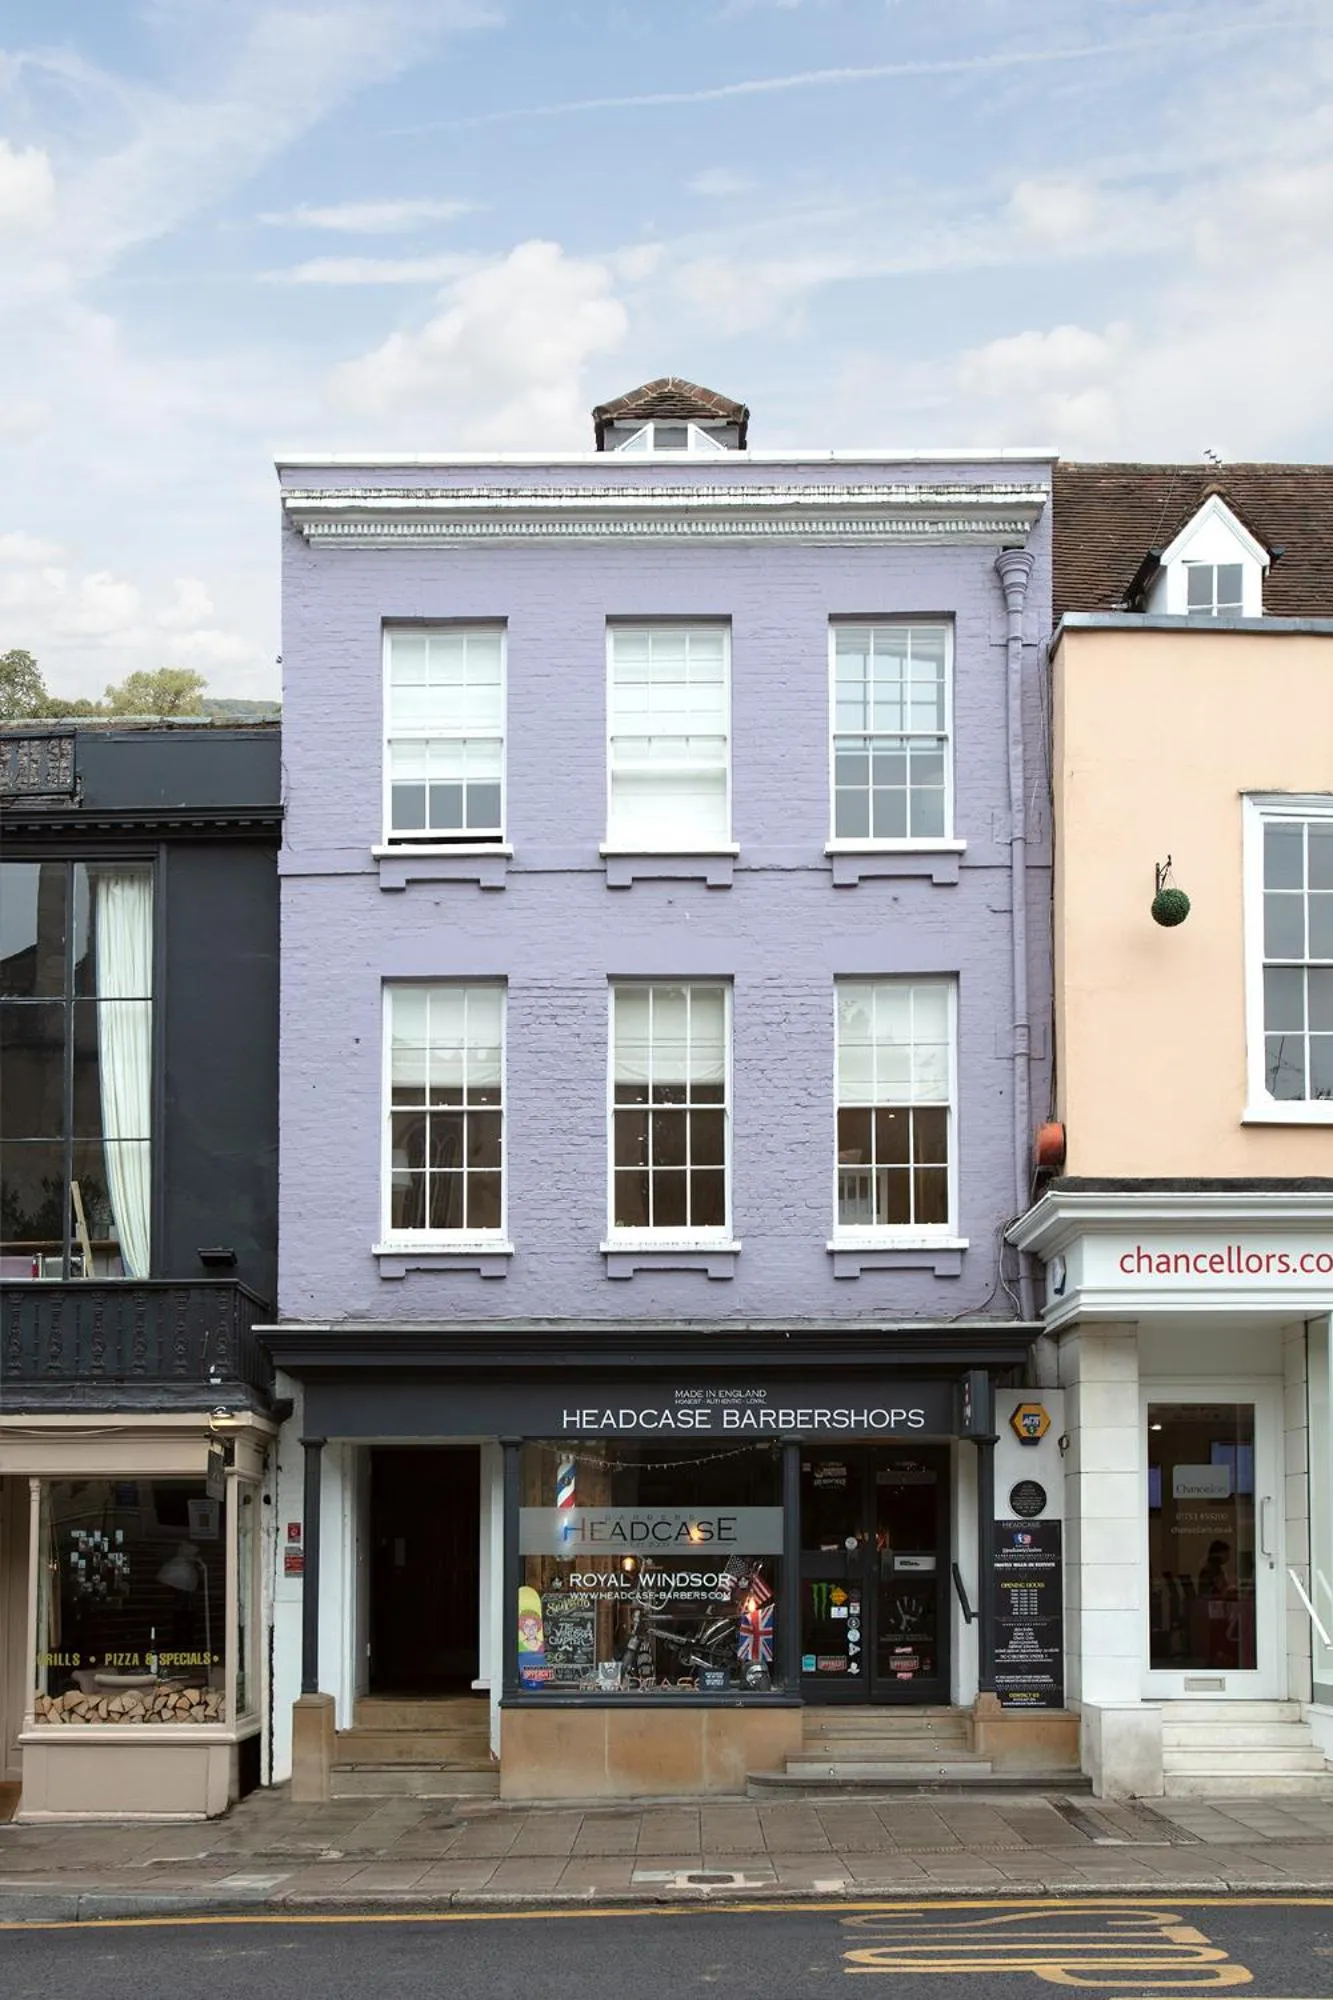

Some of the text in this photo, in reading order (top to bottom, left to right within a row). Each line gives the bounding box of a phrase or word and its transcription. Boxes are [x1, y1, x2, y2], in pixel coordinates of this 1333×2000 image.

[1119, 1245, 1333, 1273] chancellors.co
[674, 1389, 767, 1398] MADE IN ENGLAND
[562, 1409, 925, 1429] HEADCASE BARBERSHOPS
[563, 1517, 738, 1542] HEADCASE
[569, 1573, 732, 1588] ROYAL WINDSOR
[104, 1652, 140, 1666] PIZZA
[159, 1652, 212, 1666] SPECIALS
